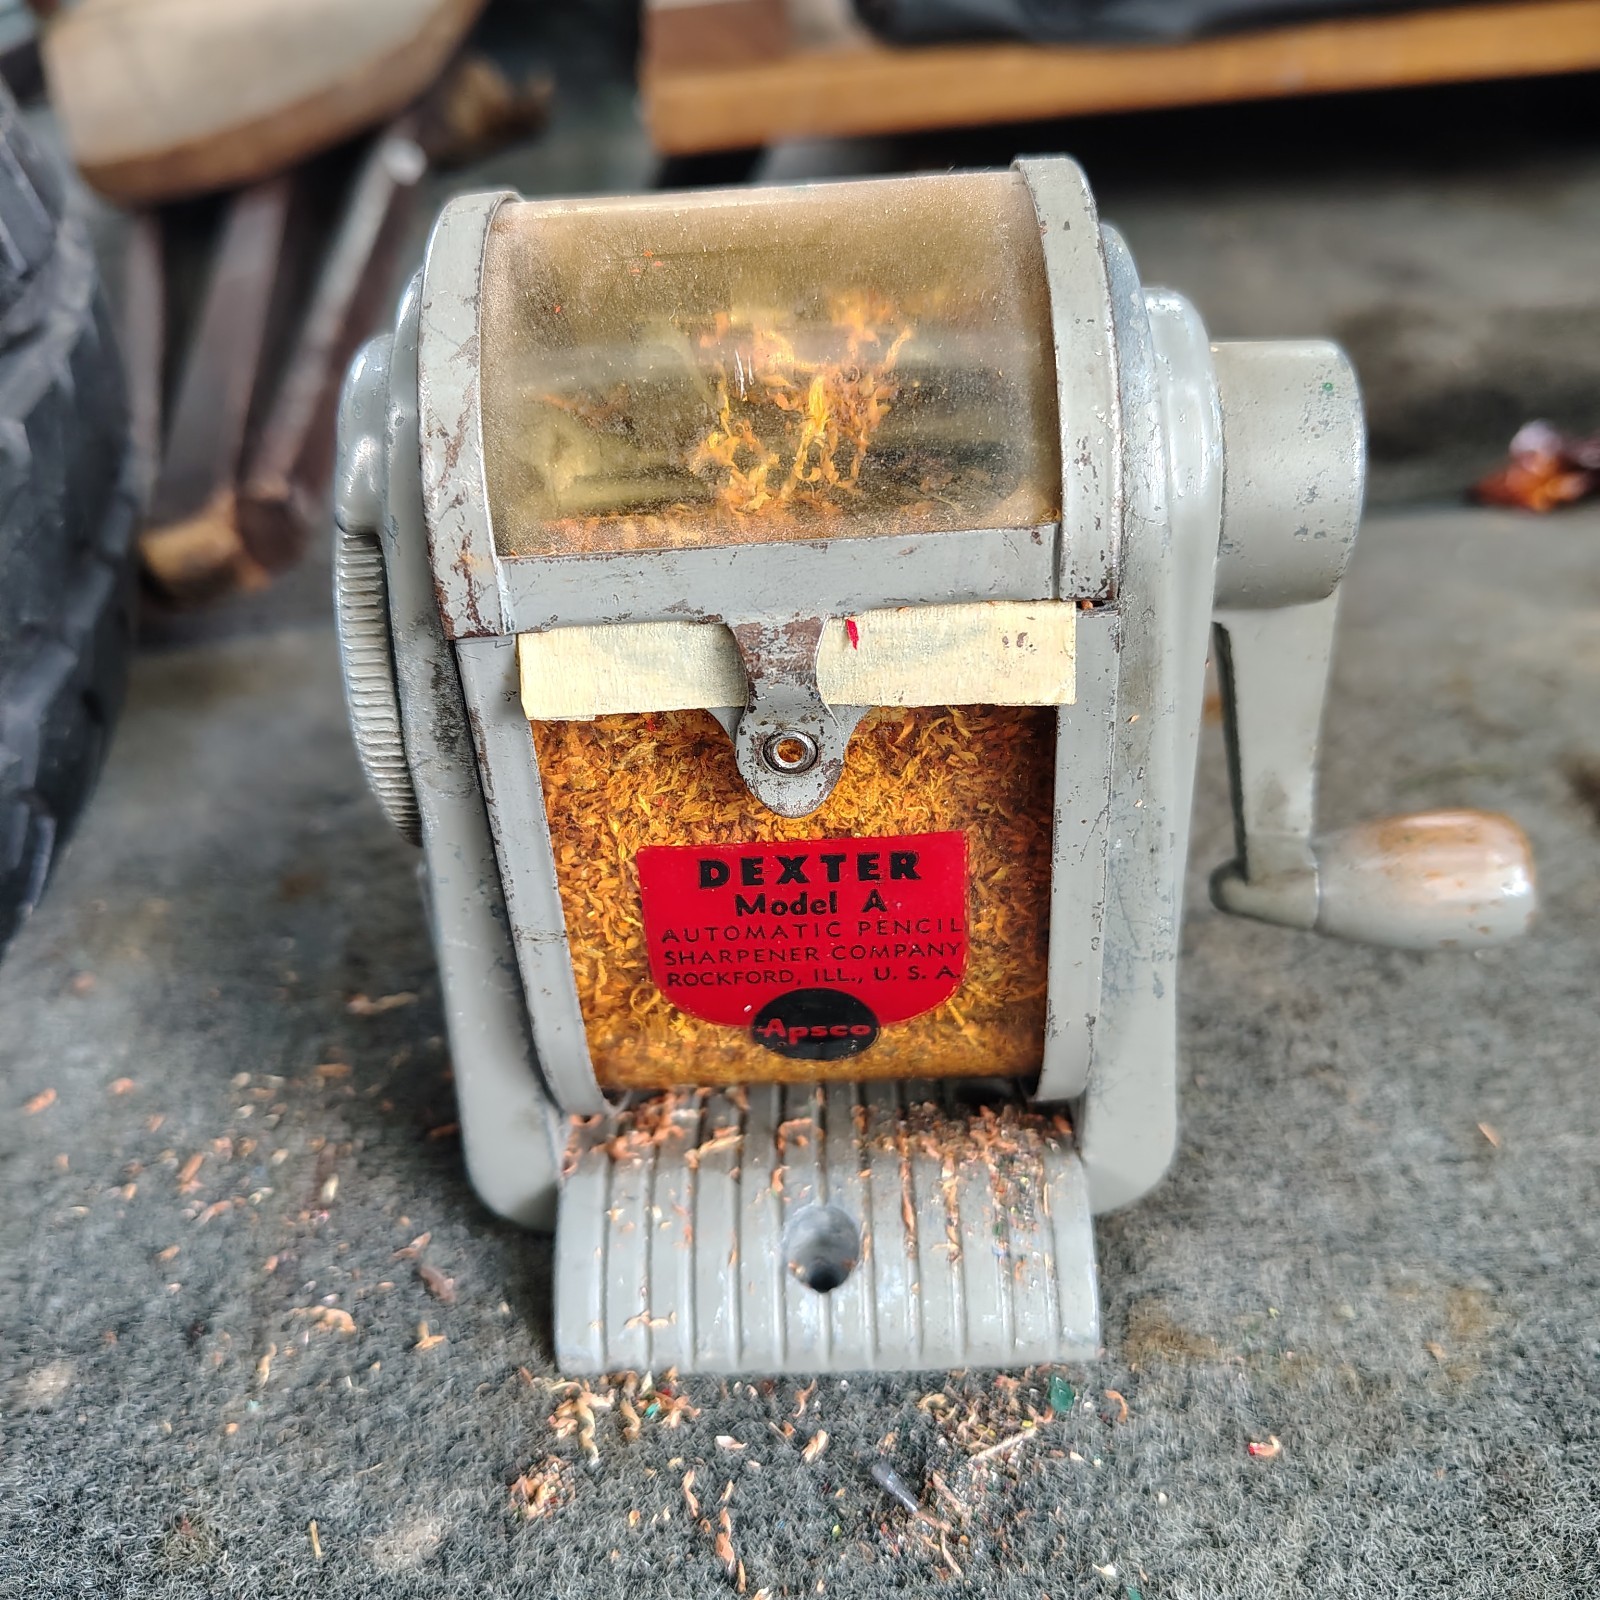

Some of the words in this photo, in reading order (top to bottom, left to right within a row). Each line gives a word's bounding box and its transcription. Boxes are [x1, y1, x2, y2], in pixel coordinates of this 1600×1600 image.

[698, 850, 922, 889] DEXTER
[735, 891, 837, 917] Model
[862, 889, 887, 913] A
[662, 921, 842, 943] AUTOMATIC
[858, 917, 963, 937] PENCIL
[665, 946, 819, 966] SHARPENER
[831, 942, 963, 960] COMPANY
[666, 969, 802, 987] ROCKFORD,
[814, 968, 862, 985] ILL.,
[874, 966, 898, 982] U.
[908, 966, 926, 981] S.
[757, 1018, 871, 1045] Apsco
